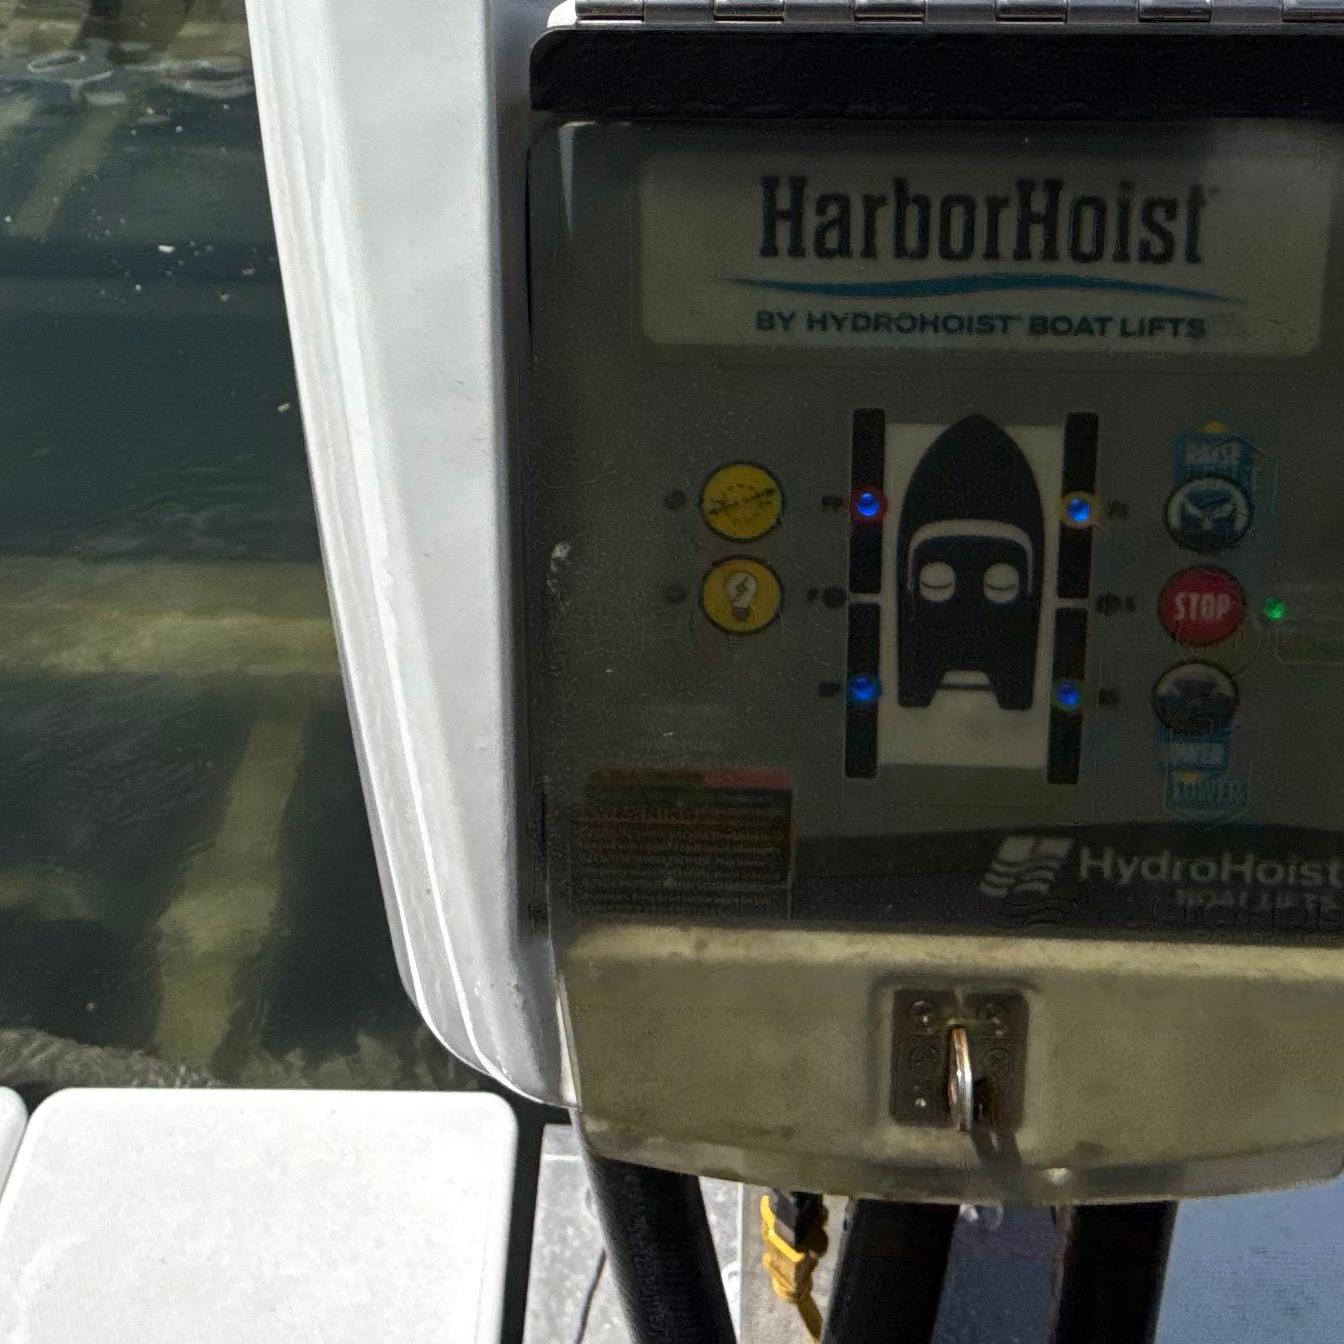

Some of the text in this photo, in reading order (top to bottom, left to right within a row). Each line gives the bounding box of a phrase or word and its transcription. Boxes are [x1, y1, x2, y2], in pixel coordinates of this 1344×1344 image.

[756, 310, 796, 333] BY
[1028, 315, 1113, 339] BOAT
[1119, 316, 1206, 340] LIFTS
[1173, 592, 1232, 621] STOP
[1080, 847, 1343, 886] HydroHoist
